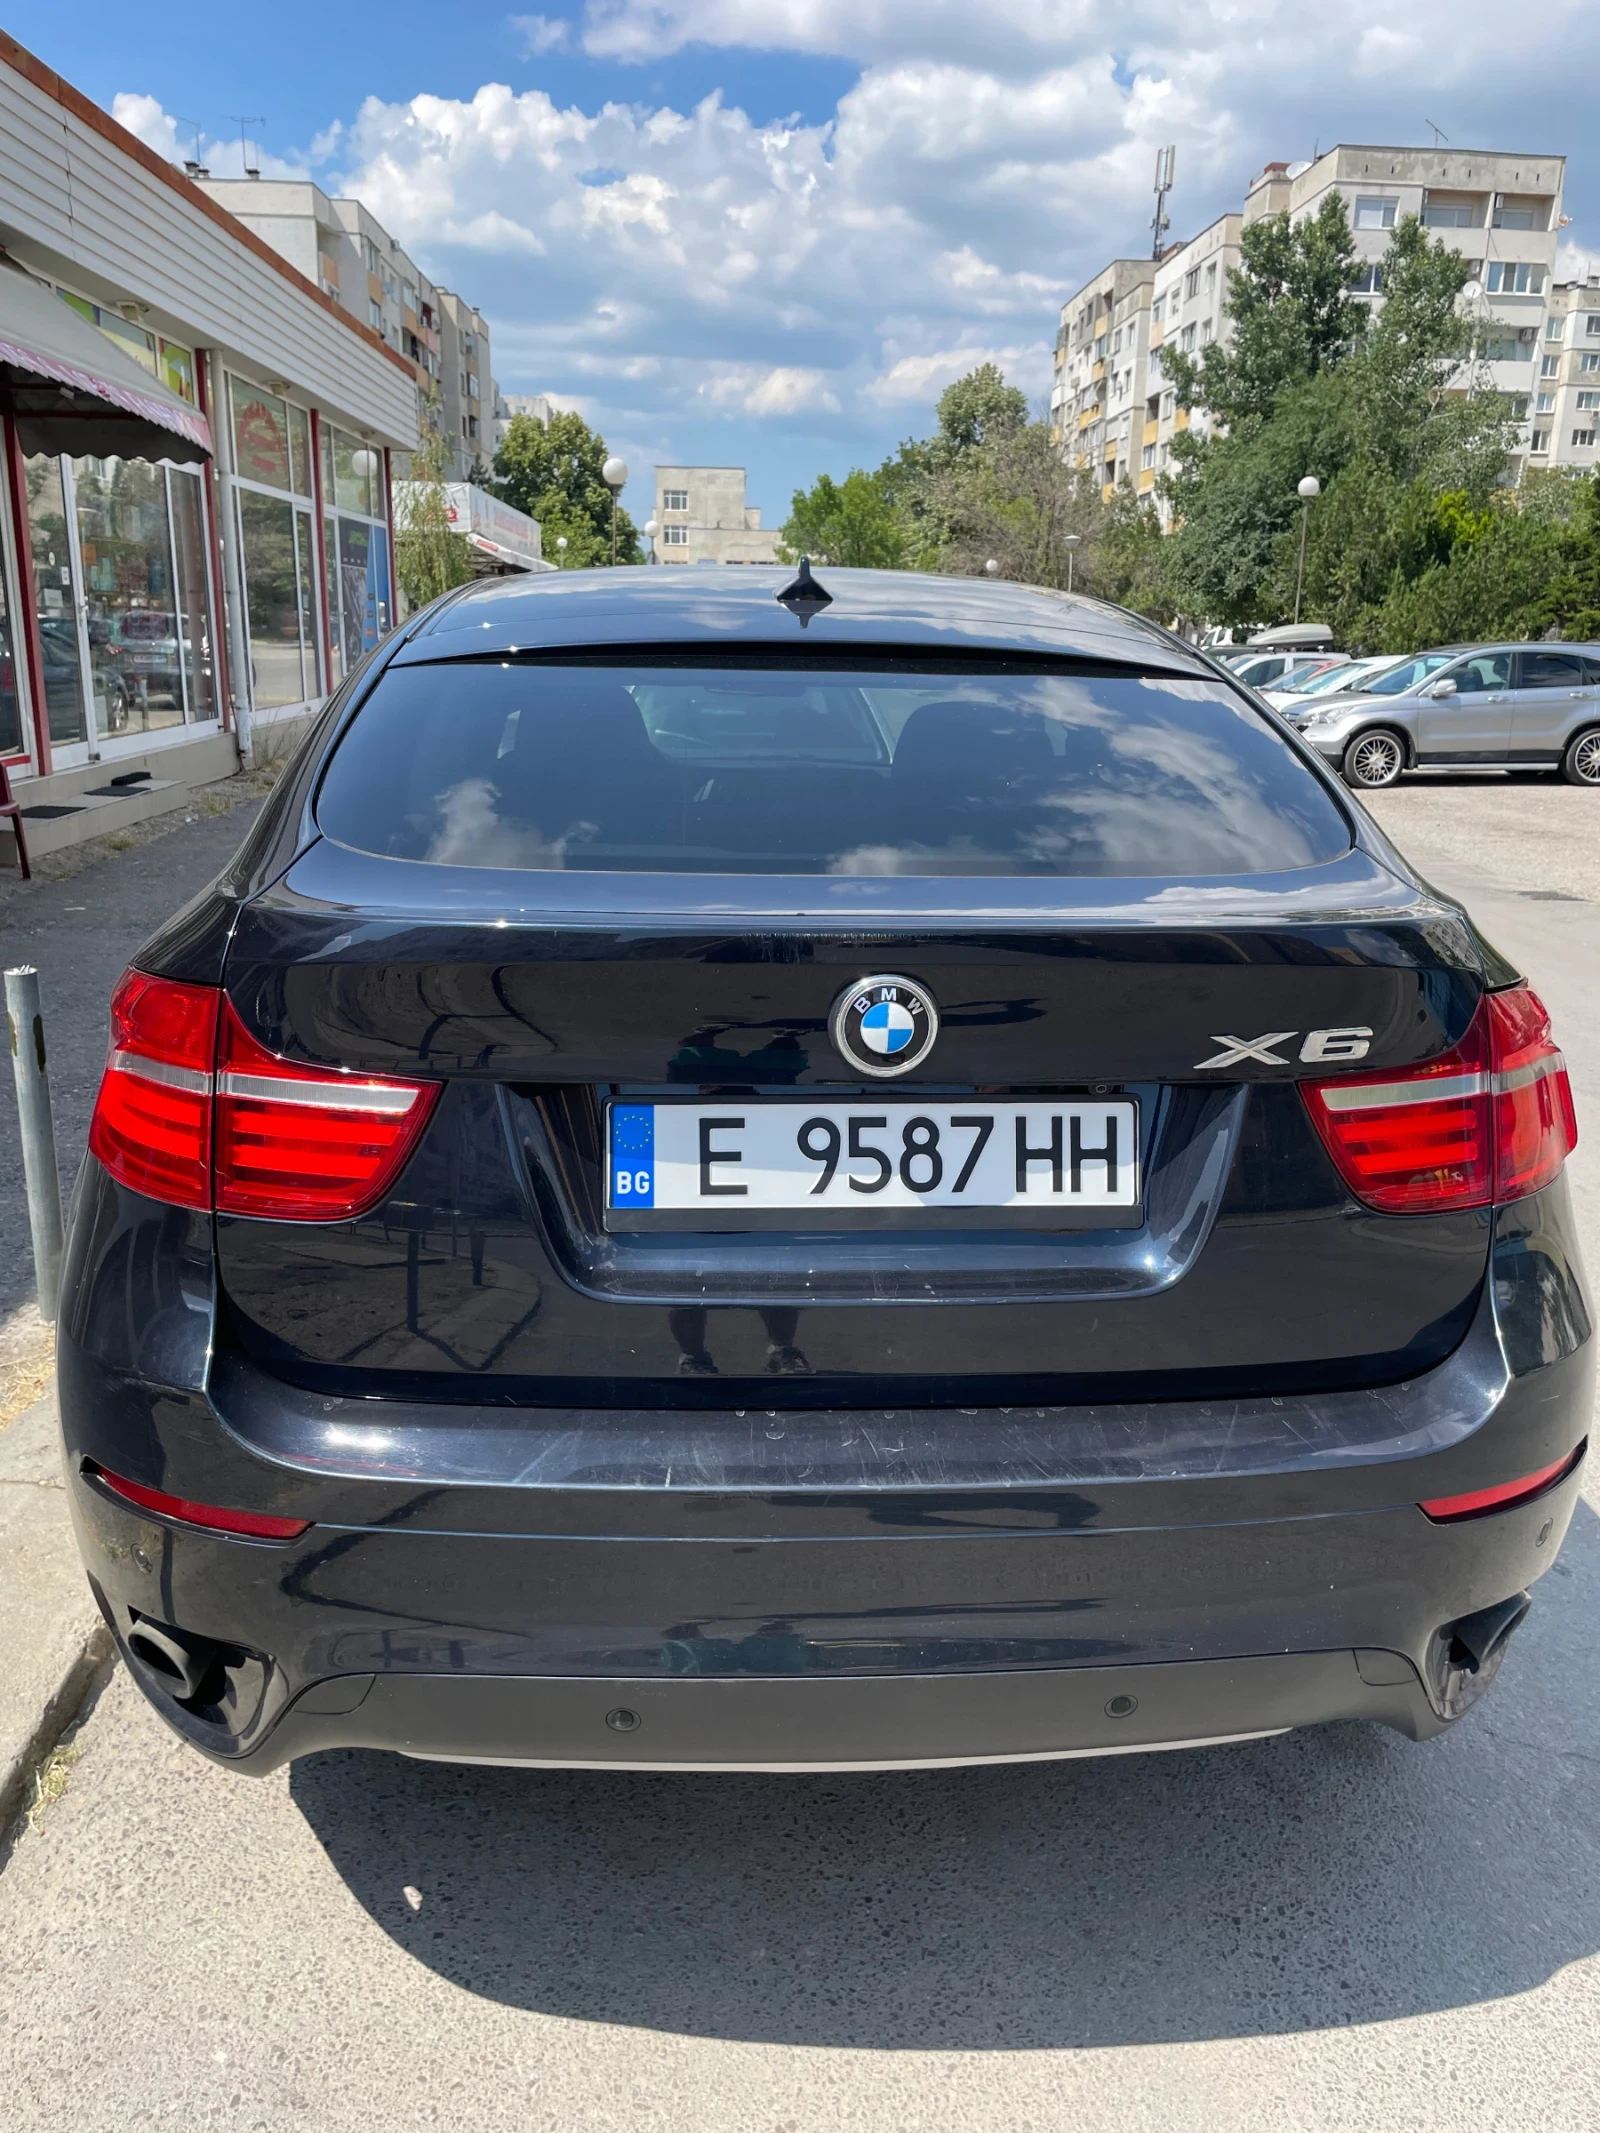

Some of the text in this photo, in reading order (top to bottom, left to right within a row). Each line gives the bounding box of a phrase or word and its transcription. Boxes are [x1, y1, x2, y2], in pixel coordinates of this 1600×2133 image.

[853, 987, 924, 1015] BMW
[1193, 1026, 1374, 1069] X6
[700, 1116, 1118, 1195] E 9587 HH
[616, 1170, 651, 1195] BG
